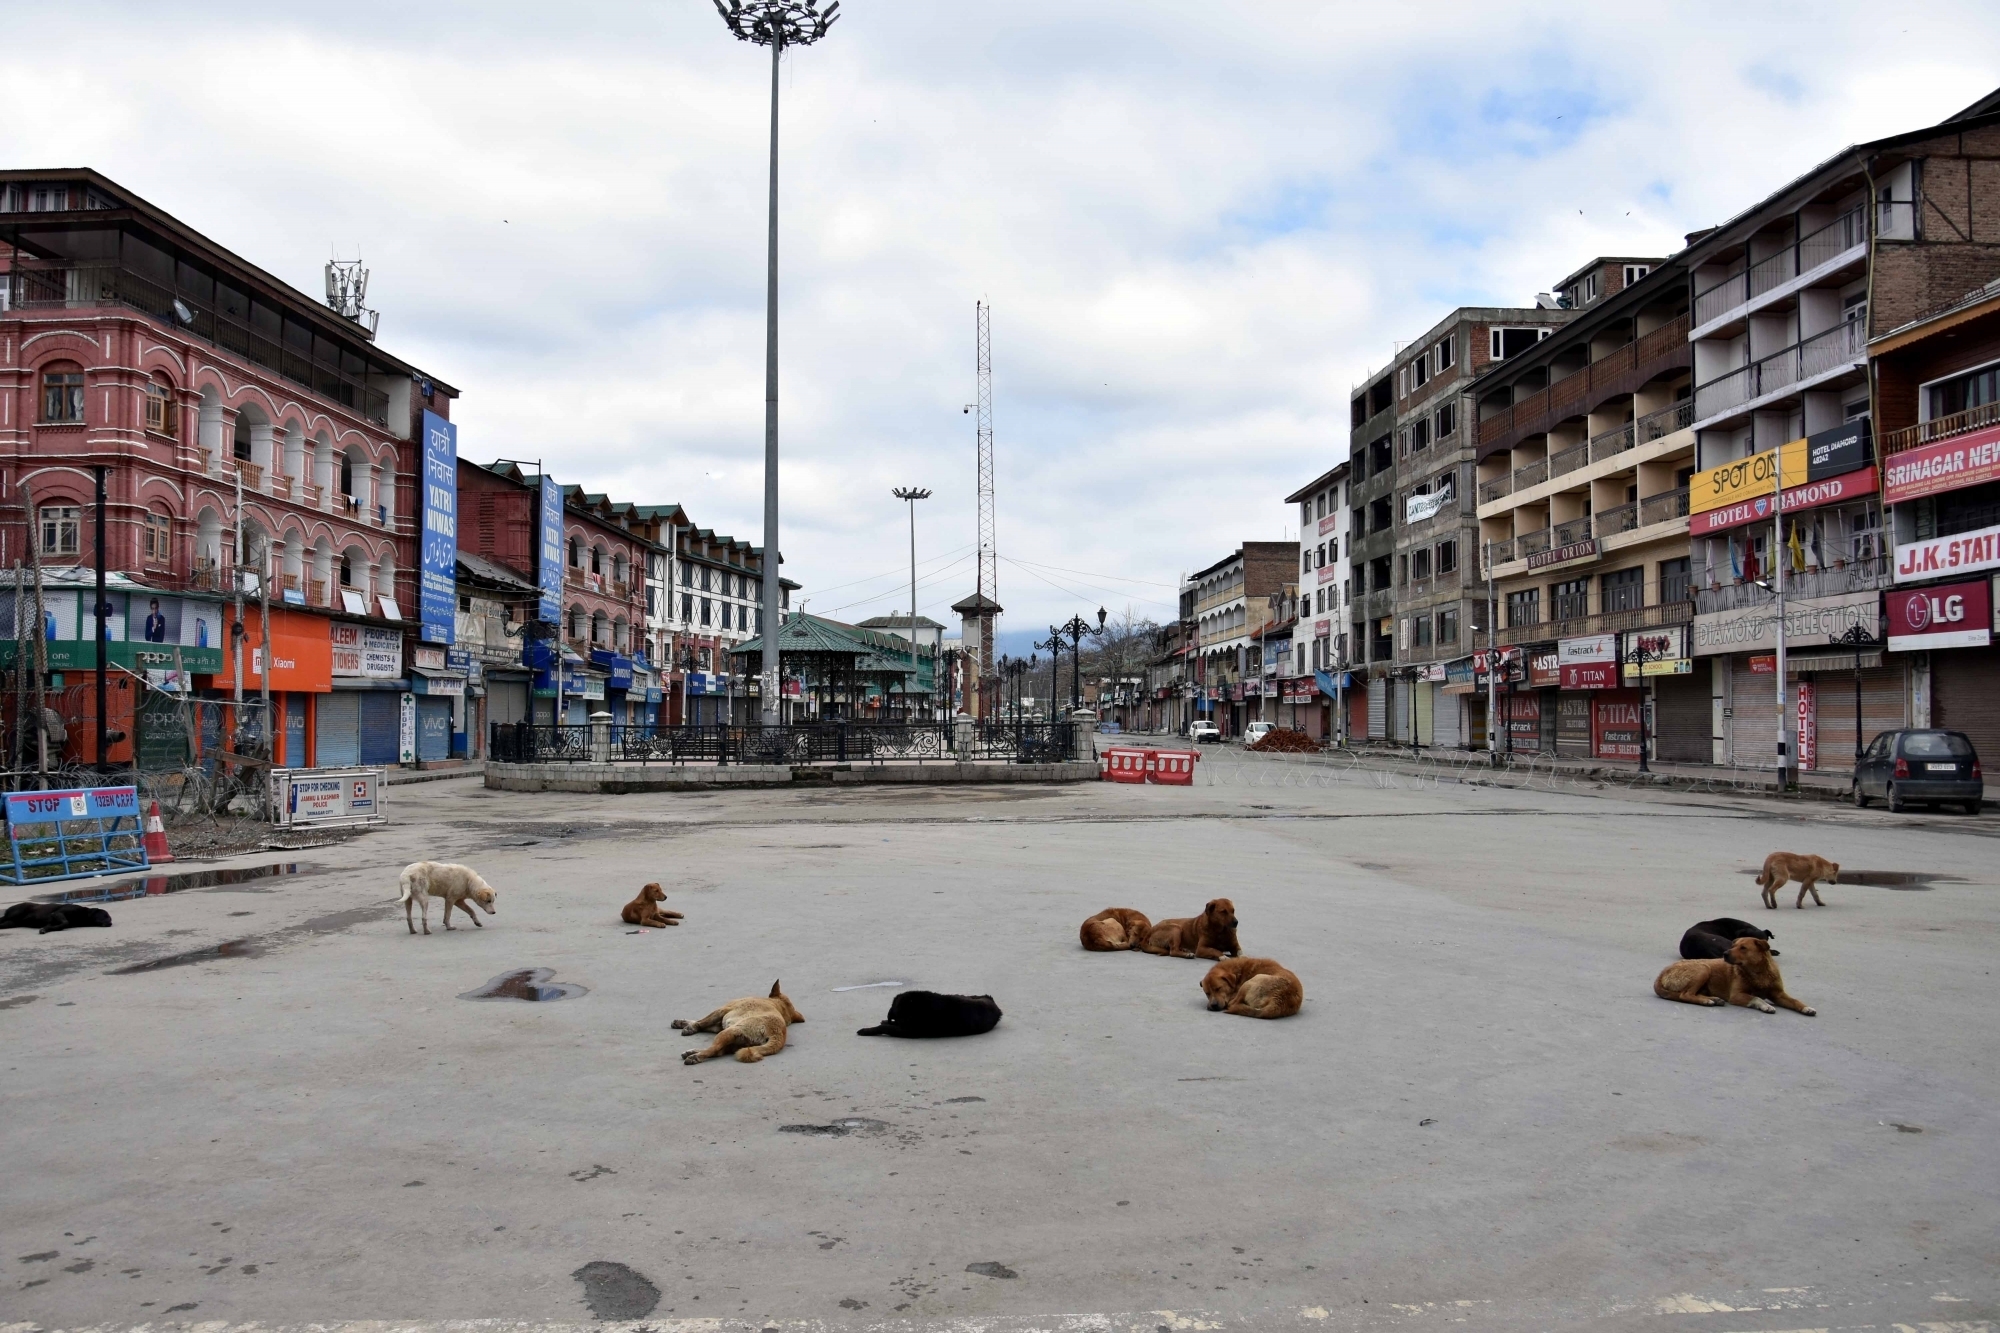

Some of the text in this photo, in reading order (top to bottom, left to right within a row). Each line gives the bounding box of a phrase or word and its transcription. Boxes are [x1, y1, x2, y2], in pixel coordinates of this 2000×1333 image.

[430, 428, 450, 456] यात्री
[1812, 436, 1857, 457] HOTEL DIAMOND
[428, 448, 453, 486] निवास
[1713, 454, 1776, 494] SPOT ON
[1886, 450, 1964, 487] SRINAGAR
[429, 484, 452, 513] YATRI
[427, 508, 454, 538] NIWAS
[1709, 504, 1752, 528] HOTEL
[546, 526, 558, 546] YATRI
[544, 542, 560, 564] NIWAS
[1530, 542, 1592, 568] HOTEL ORION
[1932, 594, 1964, 624] LG
[1699, 602, 1872, 646] DIAMOND SELECTION
[364, 628, 400, 641] PEOPLES
[368, 640, 396, 650] MEDICATE
[1568, 644, 1594, 656] fastrack
[274, 658, 295, 668] Xiaomi
[366, 654, 396, 663] CHEMISTS &
[1481, 652, 1510, 671] TIAN
[1538, 655, 1560, 670] ASTR
[366, 663, 394, 672] DRUGGISTS
[614, 668, 630, 679] SAMSUNG
[430, 679, 462, 688] KING SPORTS
[550, 670, 572, 682] SAMUNG
[1478, 674, 1502, 684] fastck
[1582, 670, 1604, 682] TITAN
[1510, 697, 1539, 716] TITAN
[1562, 700, 1588, 716] ASTRA
[142, 711, 184, 726] oppo
[423, 714, 446, 730] vivo
[1505, 721, 1531, 731] fstrack
[1798, 687, 1806, 758] HOTEL
[1599, 744, 1615, 753] SWISS
[300, 782, 340, 792] STOP FOR CHECKING
[28, 798, 59, 813] STOP
[95, 796, 114, 808] 132BN
